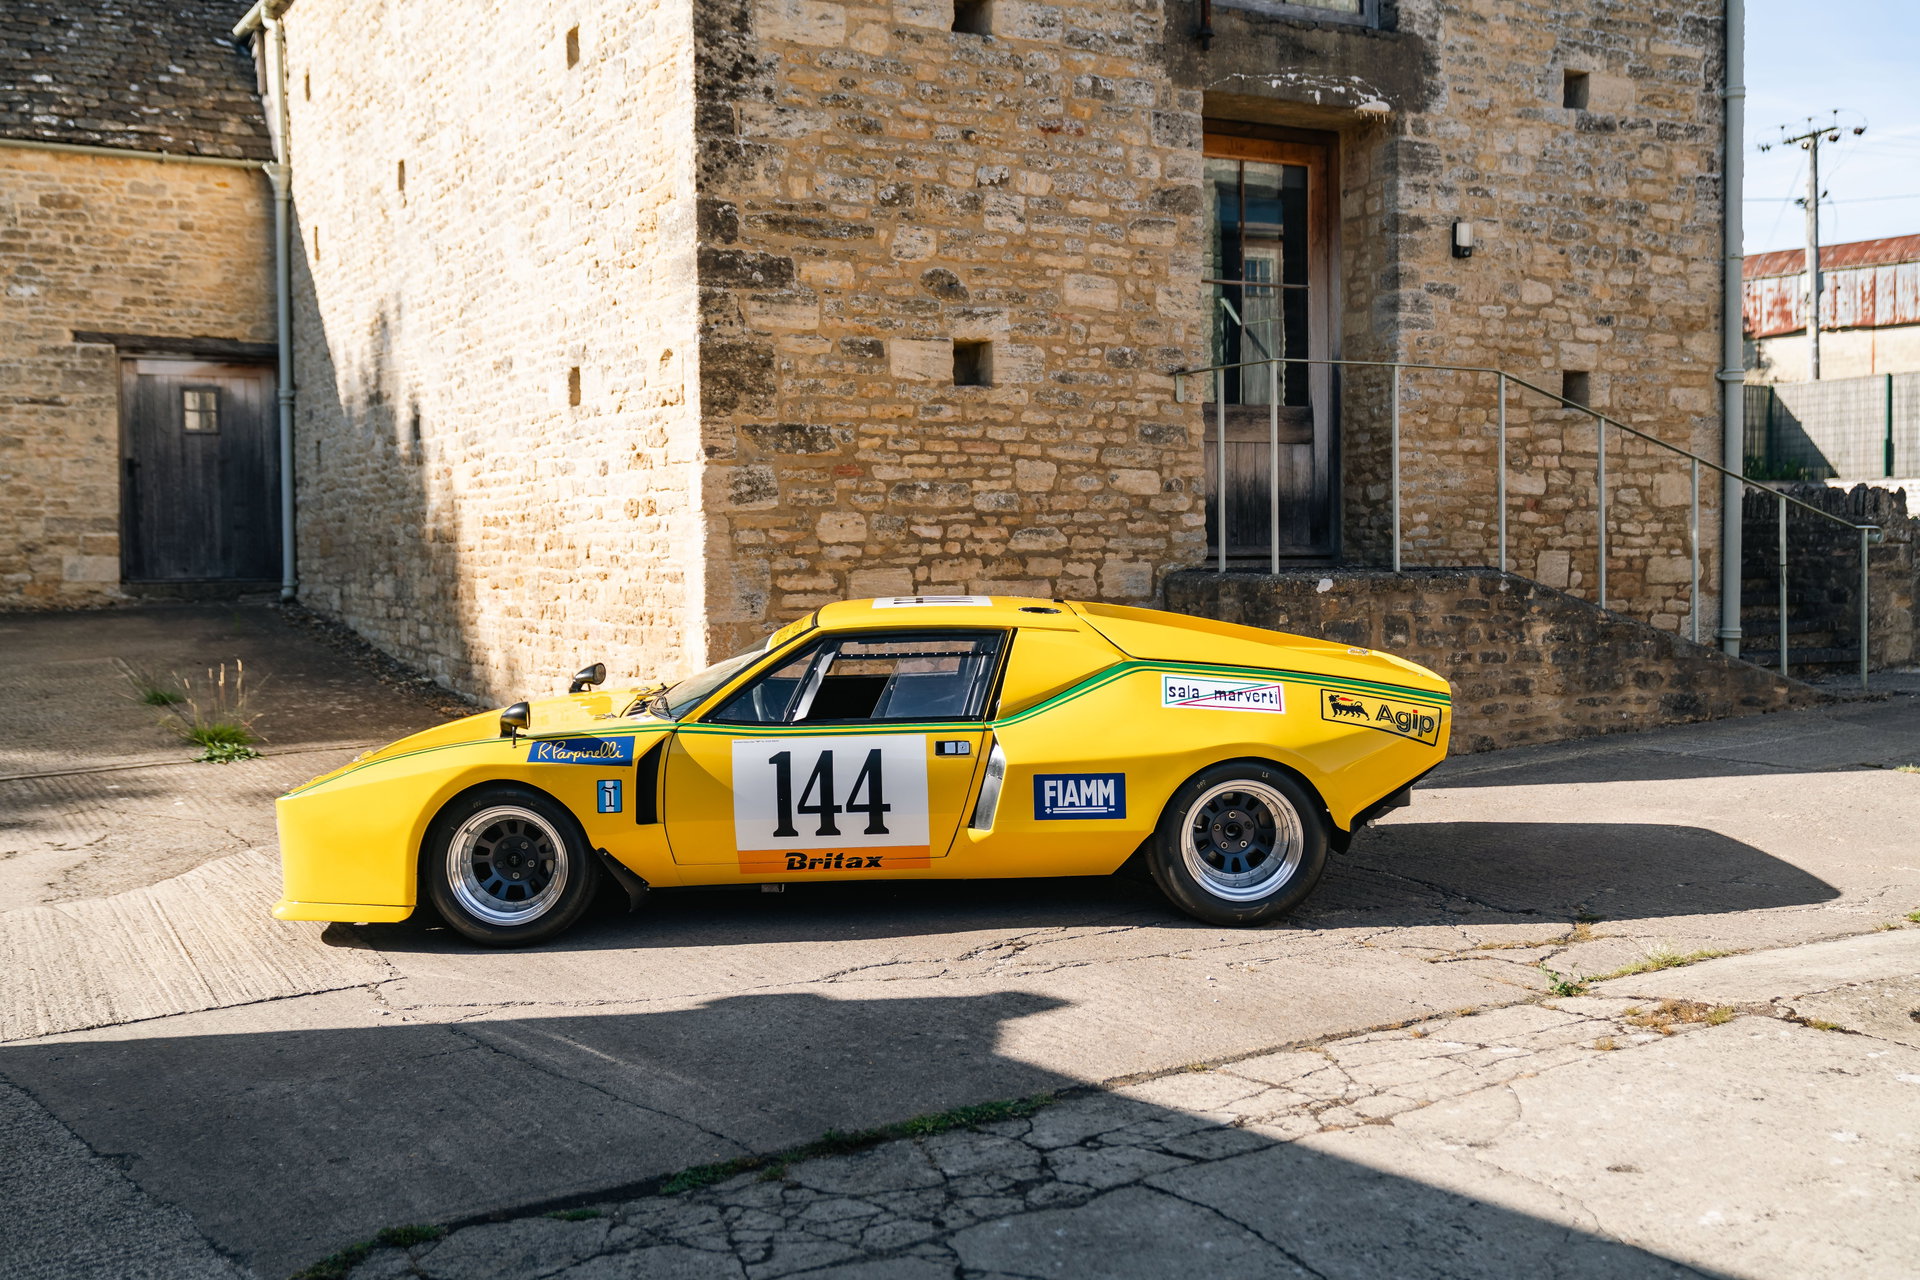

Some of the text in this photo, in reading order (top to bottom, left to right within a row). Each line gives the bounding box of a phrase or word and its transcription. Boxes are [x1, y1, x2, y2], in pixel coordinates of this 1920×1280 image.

[1168, 685, 1278, 705] sala marverti
[1375, 704, 1435, 737] Agip
[768, 748, 891, 838] 144
[1044, 779, 1115, 807] FIAMM
[784, 852, 884, 871] Britax
